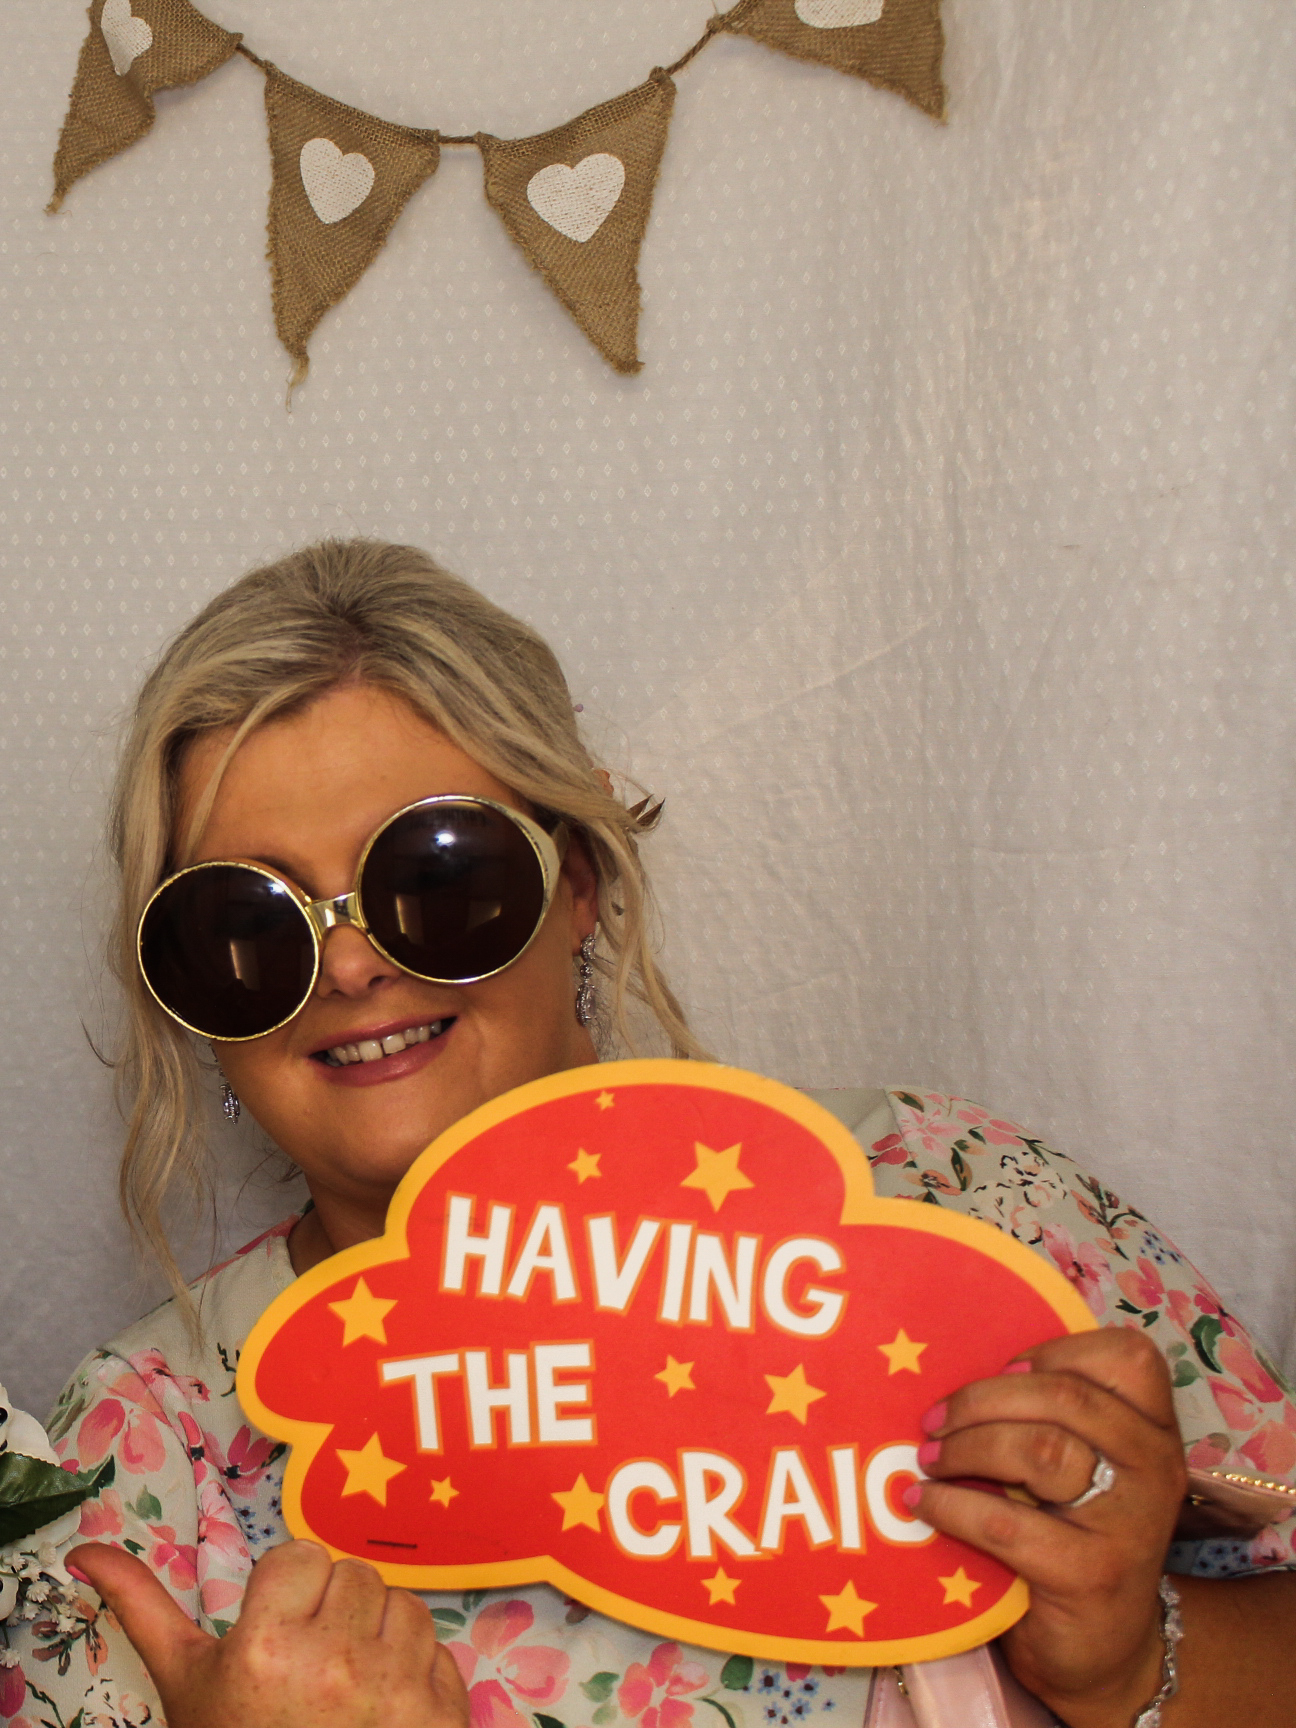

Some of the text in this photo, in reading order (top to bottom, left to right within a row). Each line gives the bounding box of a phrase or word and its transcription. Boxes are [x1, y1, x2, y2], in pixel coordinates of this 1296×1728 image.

[442, 1196, 845, 1337] HAVING
[382, 1344, 593, 1451] THE
[608, 1444, 936, 1557] CRAIC
